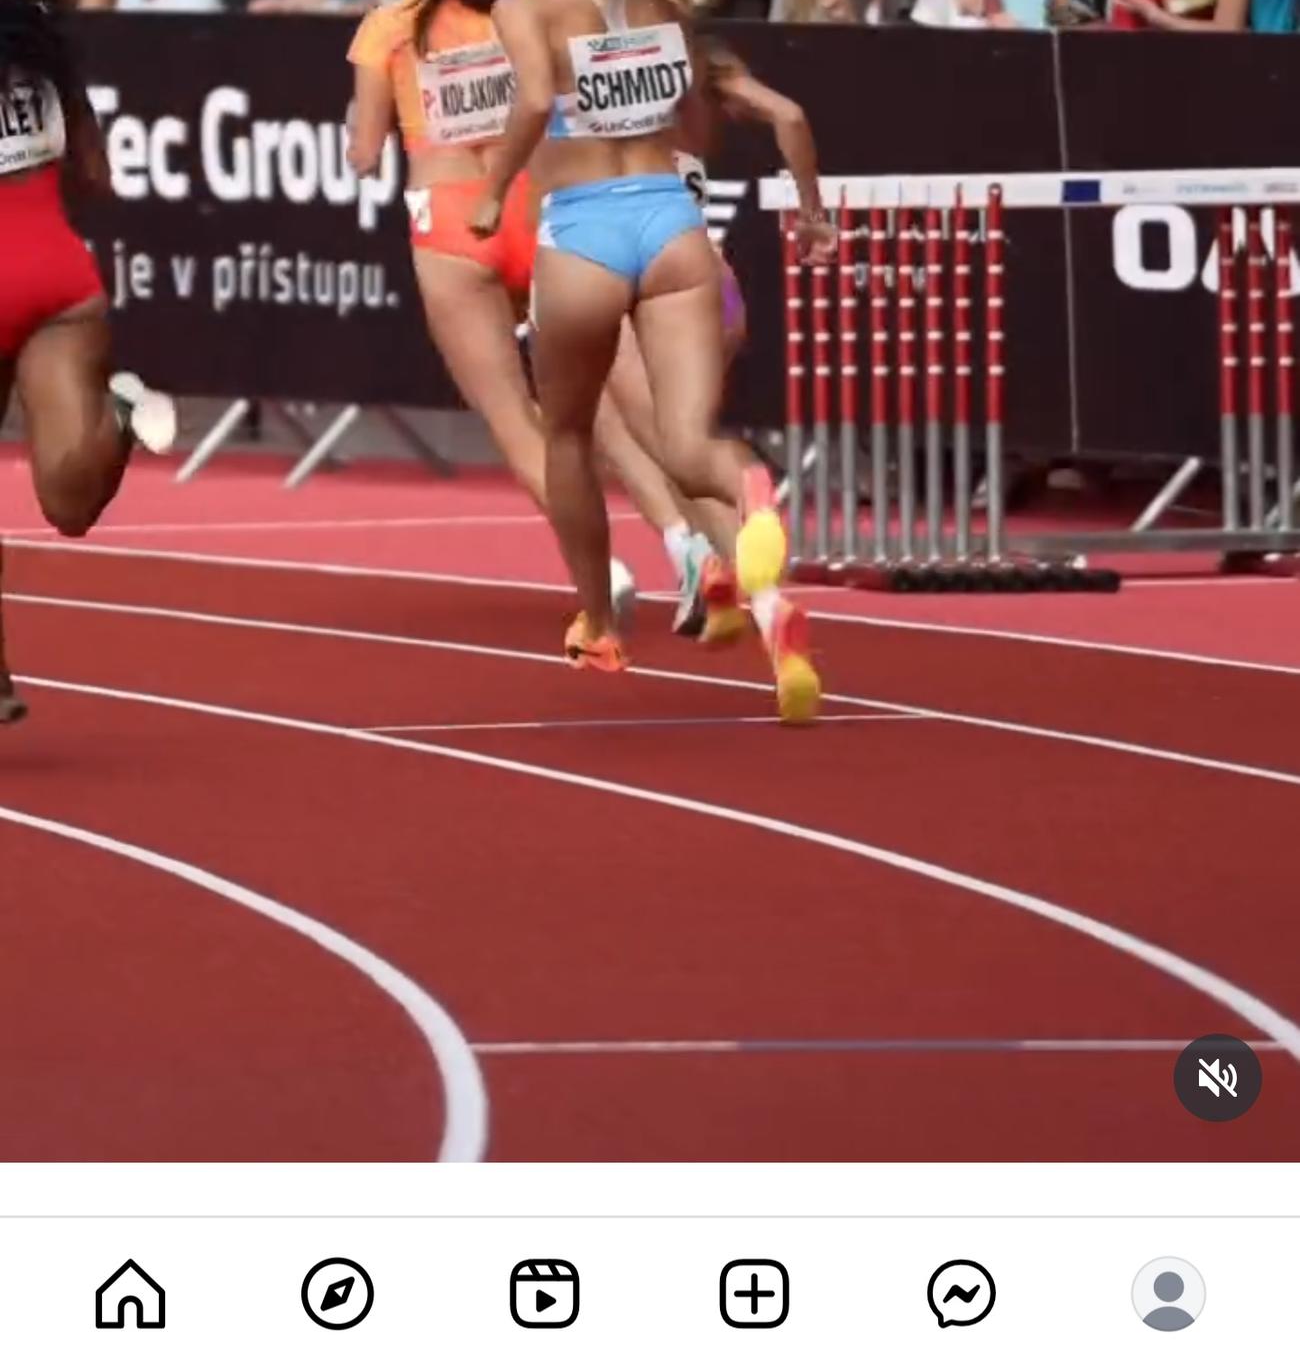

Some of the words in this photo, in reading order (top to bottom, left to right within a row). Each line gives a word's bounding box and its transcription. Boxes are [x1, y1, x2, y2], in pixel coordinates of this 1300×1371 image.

[577, 59, 687, 111] SCHMIDT
[114, 241, 152, 307] je
[172, 258, 193, 296] v
[214, 244, 396, 314] přístupu.
